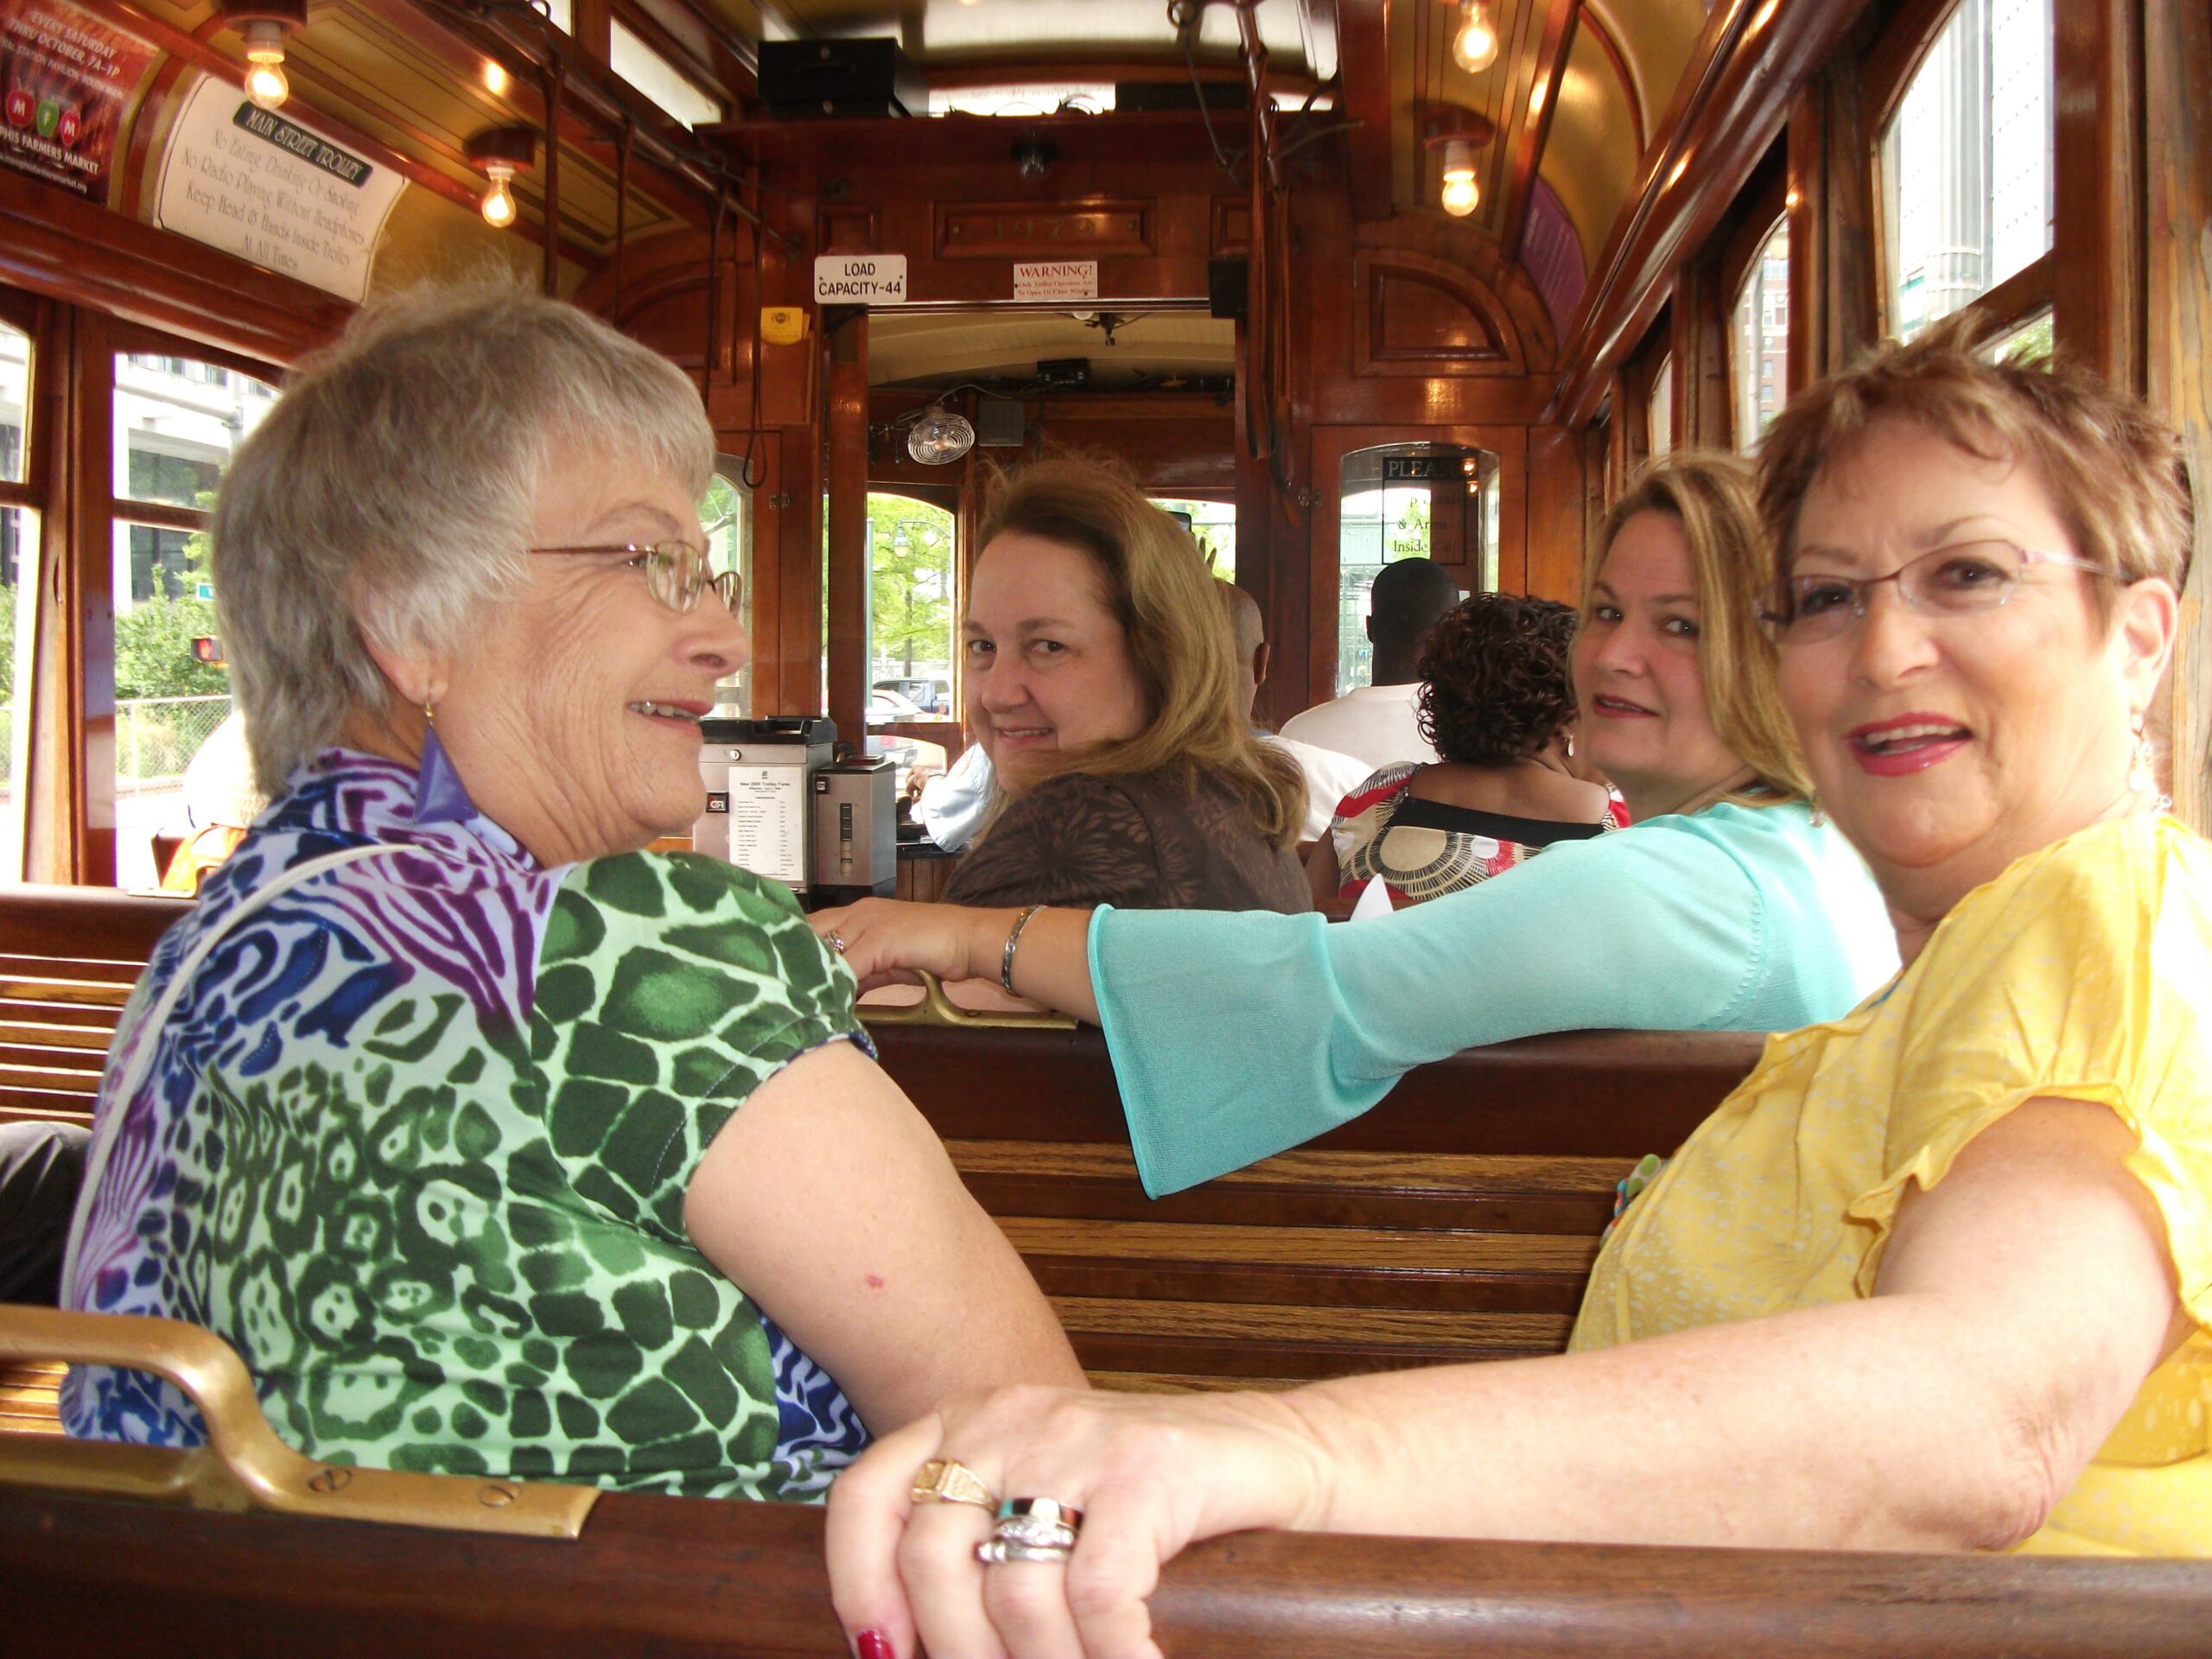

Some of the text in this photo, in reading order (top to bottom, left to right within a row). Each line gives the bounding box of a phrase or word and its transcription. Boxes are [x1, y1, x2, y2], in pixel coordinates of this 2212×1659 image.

[9, 18, 38, 40] THRU
[31, 12, 117, 59] EVERY SATURDAY
[14, 99, 26, 117] M
[213, 130, 227, 149] No
[246, 110, 364, 181] MAIN STREET TROLLEY
[22, 135, 63, 162] FARMERS
[64, 149, 99, 175] MARKET
[182, 148, 198, 169] No
[200, 156, 234, 185] Radio
[237, 172, 272, 210] Playing
[276, 190, 312, 222] Without
[187, 180, 352, 266] Keep Head & Hands Inside Trolley
[273, 245, 299, 270] Times
[844, 263, 876, 276] LOAD
[1020, 264, 1093, 277] WARNING!
[818, 282, 901, 296] CAPACITY-44
[1398, 518, 1407, 530] &
[1394, 539, 1428, 552] Inside
